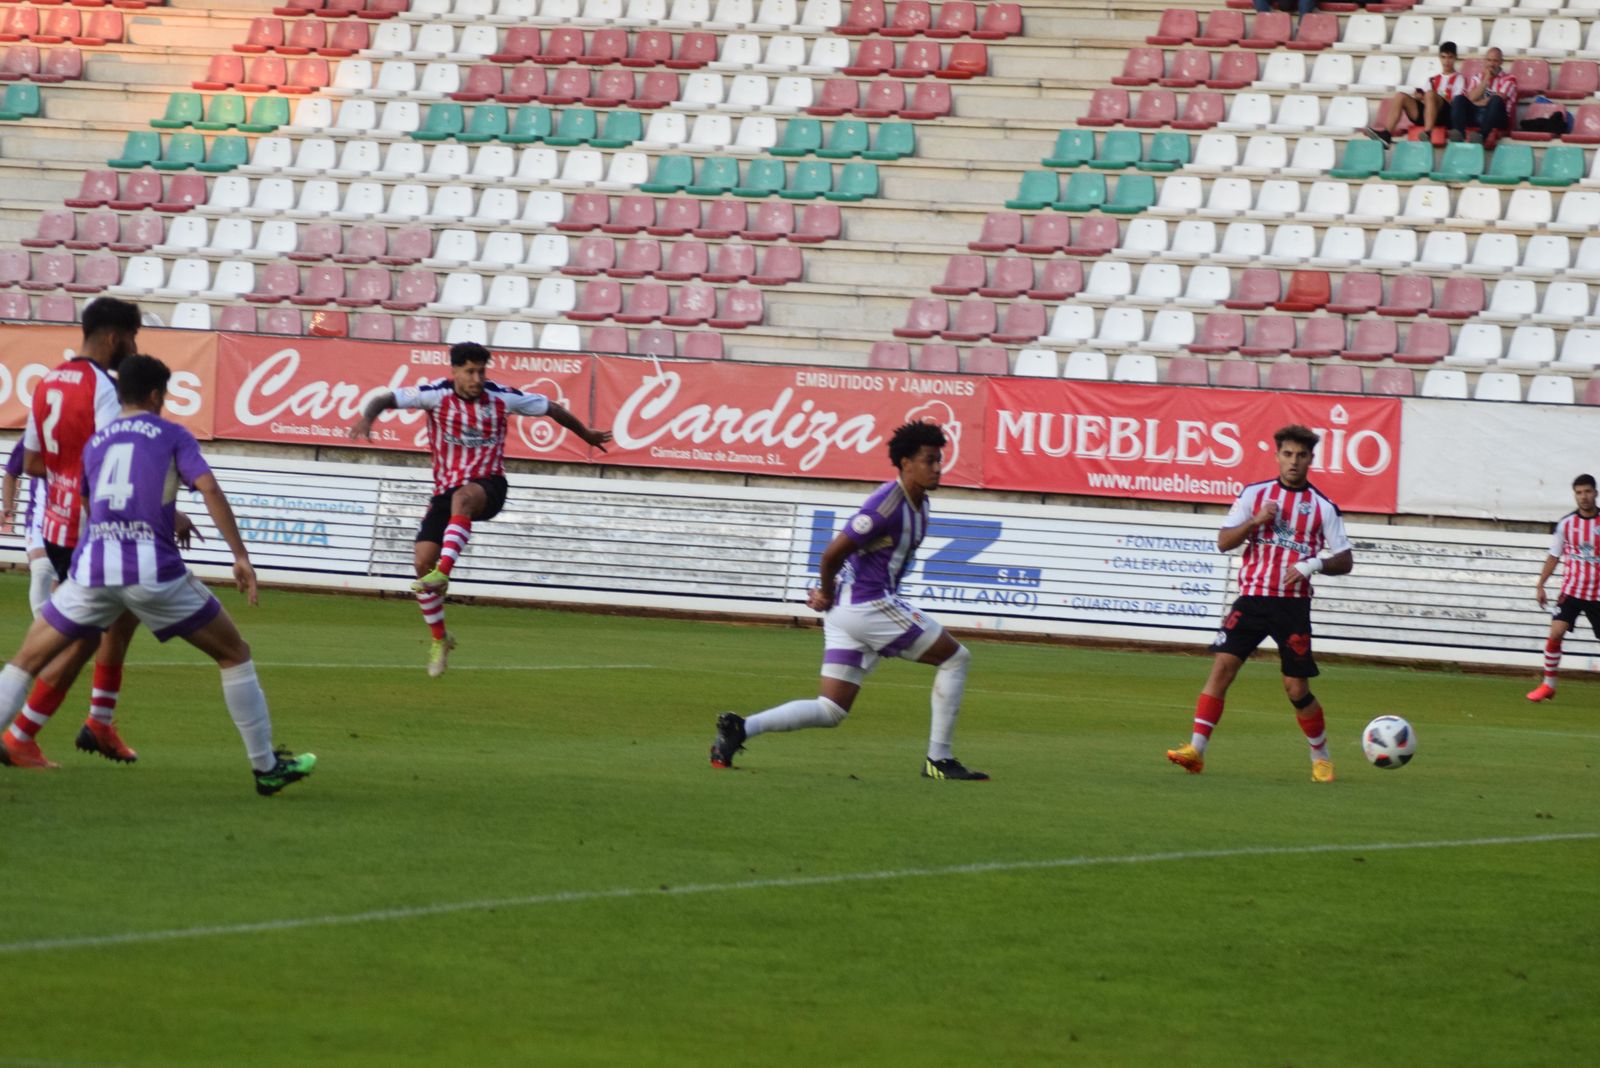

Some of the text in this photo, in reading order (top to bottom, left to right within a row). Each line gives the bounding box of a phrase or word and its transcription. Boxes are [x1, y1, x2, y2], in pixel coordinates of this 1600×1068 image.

[411, 349, 582, 374] EMBUS Y JAMONES
[796, 372, 975, 396] EMBUTIDOS Y JAMONES
[42, 389, 63, 455] 2
[612, 371, 883, 471] Cardiza
[995, 409, 1244, 468] MUEBLES
[714, 451, 727, 461] de
[95, 443, 136, 510] 4
[1180, 582, 1211, 596] GAS
[1071, 597, 1140, 613] CUARTOS
[1143, 600, 1164, 614] DE
